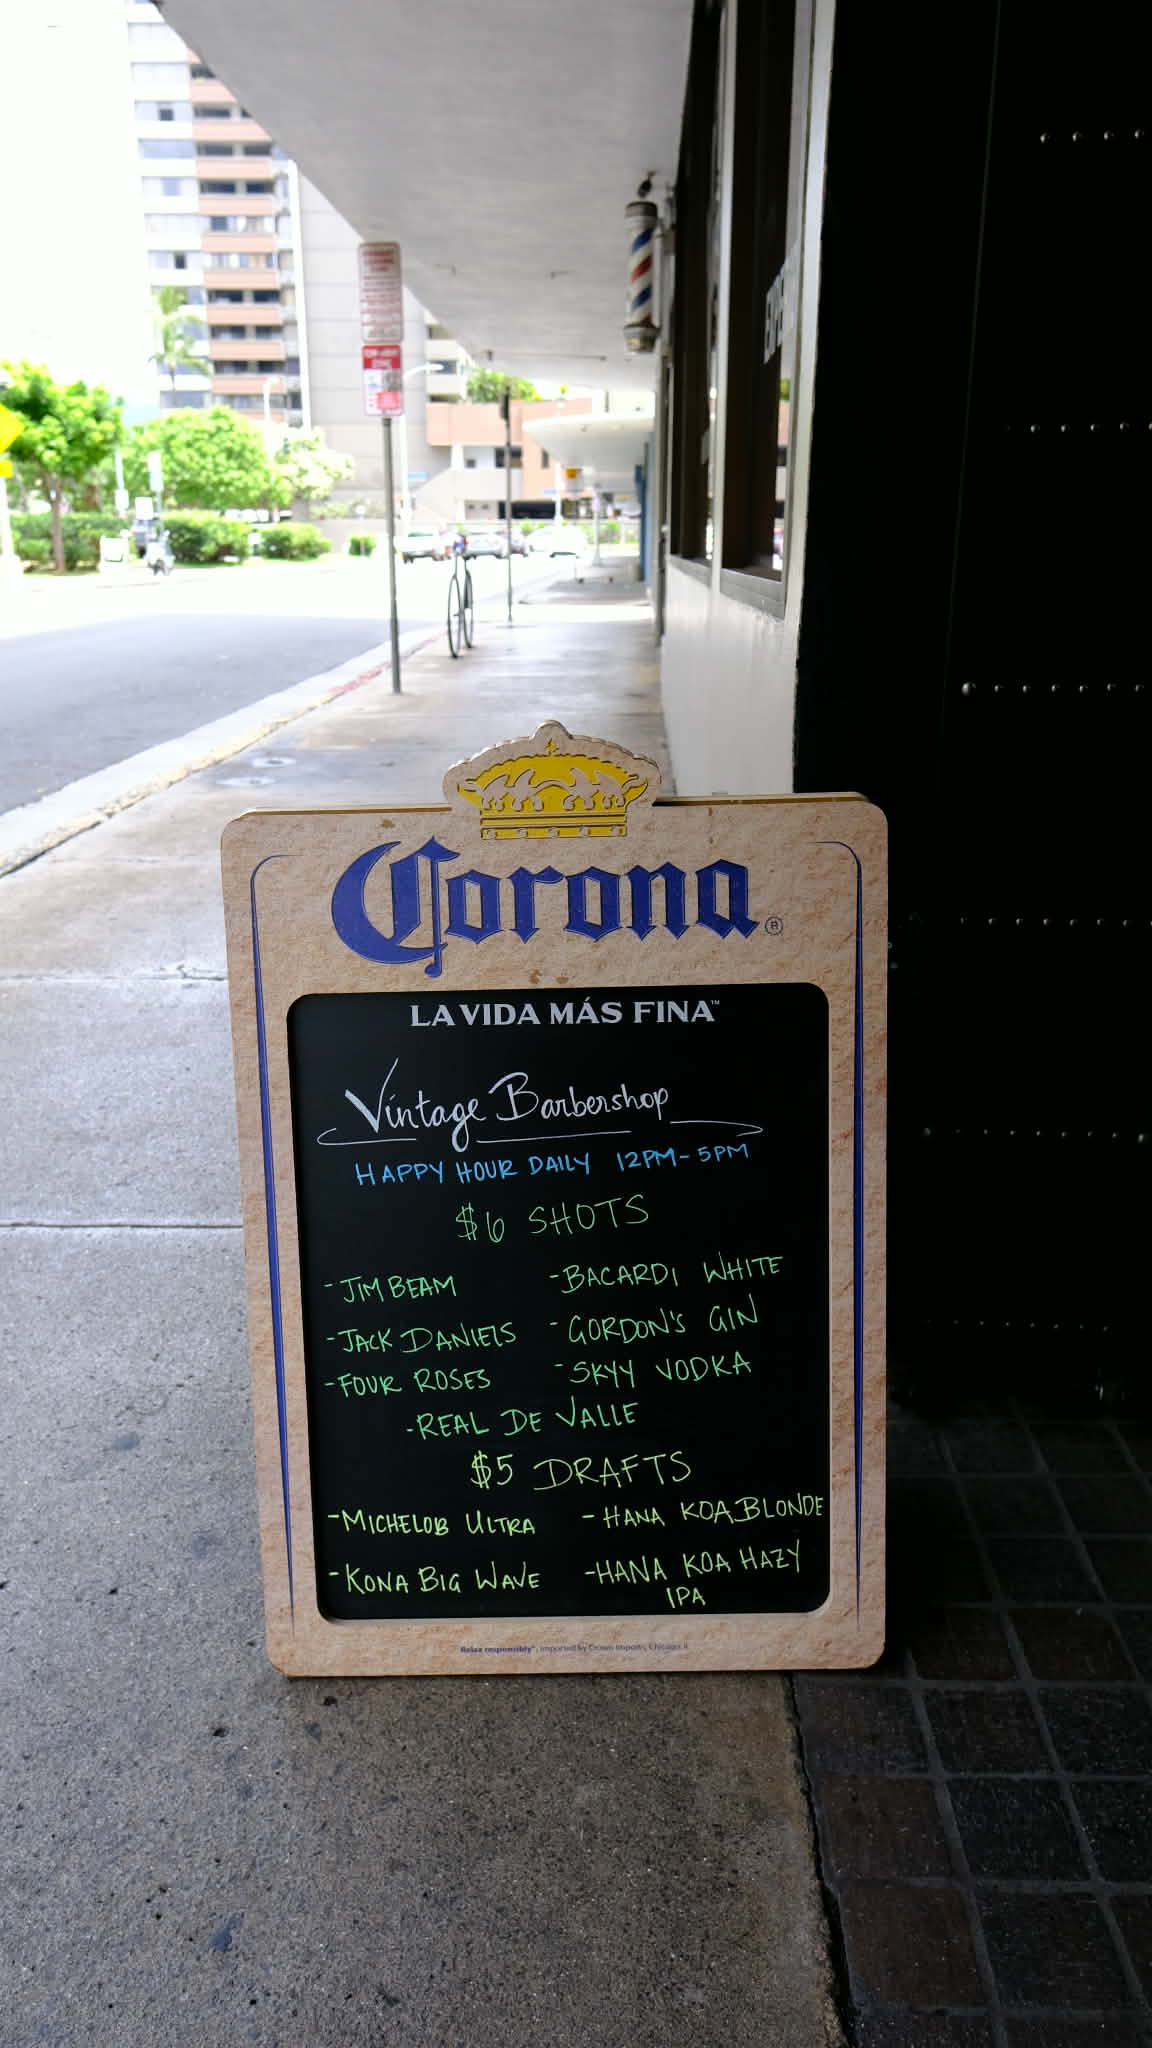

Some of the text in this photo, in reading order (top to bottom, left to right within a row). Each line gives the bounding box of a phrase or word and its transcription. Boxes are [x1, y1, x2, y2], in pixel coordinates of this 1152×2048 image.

[411, 1005, 455, 1026] LA
[459, 1004, 541, 1025] VIDA
[550, 997, 622, 1024] MÁS
[346, 1058, 668, 1152] Vintage Barbershop
[355, 1160, 443, 1185] HAPPY
[456, 1160, 517, 1184] HOUR
[528, 1152, 589, 1175] DAILY
[698, 1144, 748, 1161] 5PM
[456, 1194, 648, 1243] $6 SHOTS
[704, 1252, 782, 1283] WHITE
[388, 1276, 456, 1298] BEAM
[710, 1294, 757, 1331] GIN
[400, 1322, 516, 1353] DANIELS
[413, 1368, 490, 1392] ROSES
[656, 1352, 751, 1381] VODKA
[500, 1409, 541, 1436] DE
[555, 1396, 638, 1428] VALLE
[471, 1450, 691, 1490] $5 DRAFTS
[466, 1510, 535, 1536] ULTRA
[683, 1552, 731, 1578] KOA
[740, 1540, 799, 1572] HAZY
[418, 1567, 461, 1592] BIG
[475, 1561, 540, 1590] WAVE
[666, 1587, 705, 1608] IPA
